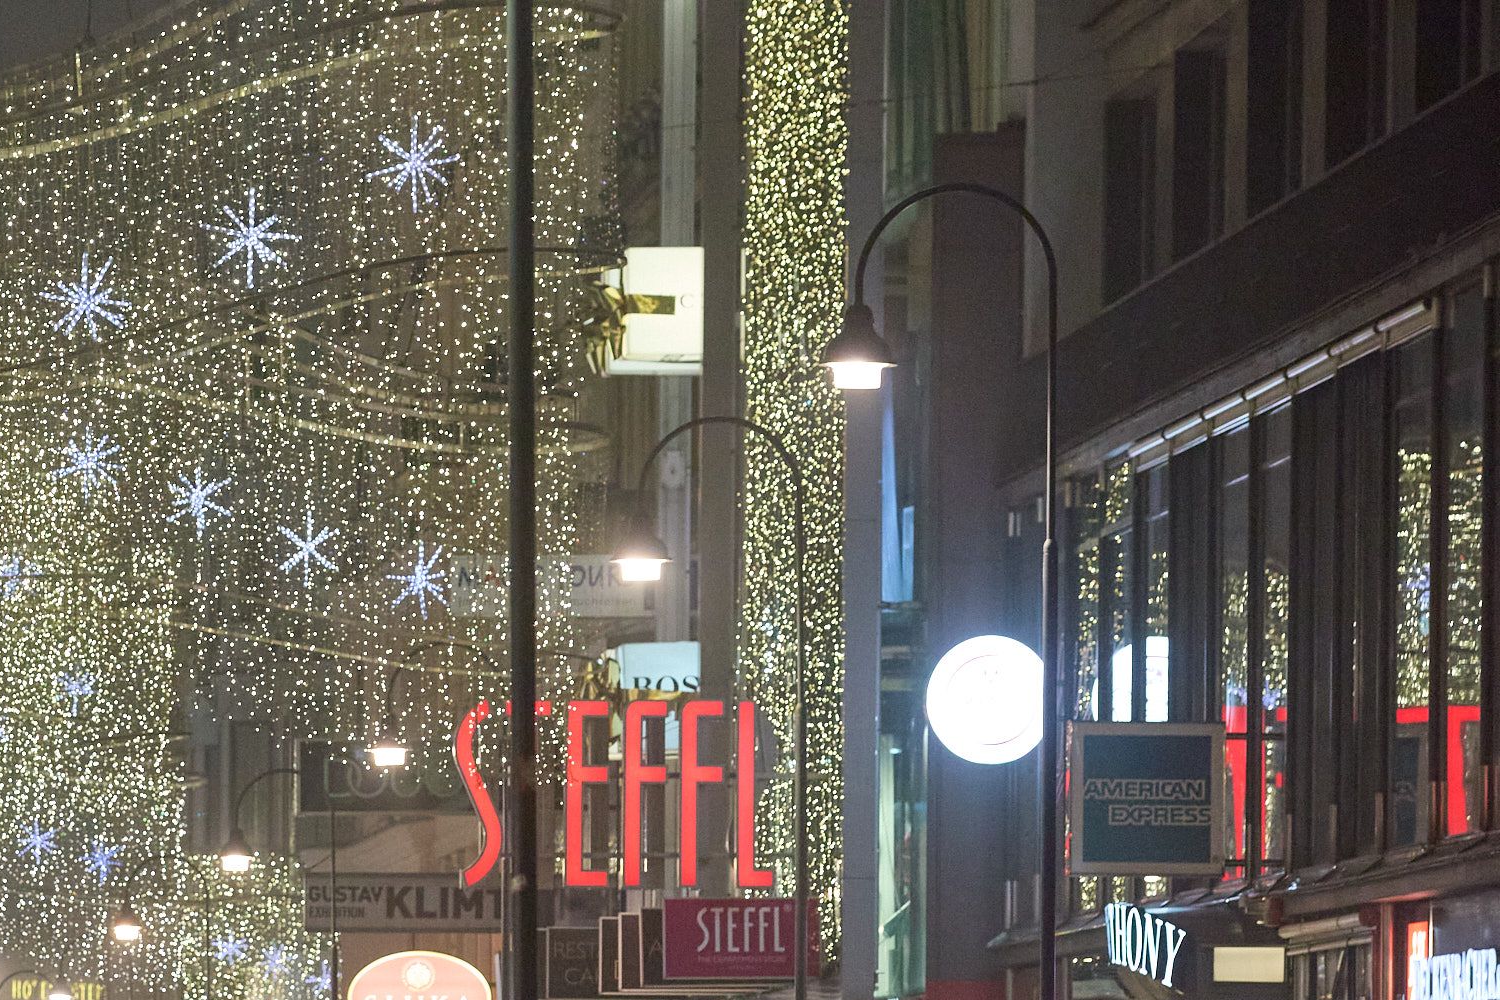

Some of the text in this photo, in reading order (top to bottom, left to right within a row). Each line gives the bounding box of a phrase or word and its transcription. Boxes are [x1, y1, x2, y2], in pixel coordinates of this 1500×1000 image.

[1084, 778, 1206, 800] AMERICAN
[1108, 804, 1212, 826] EXPRESS
[310, 885, 383, 904] GUSTAV
[696, 906, 786, 953] STEFFL
